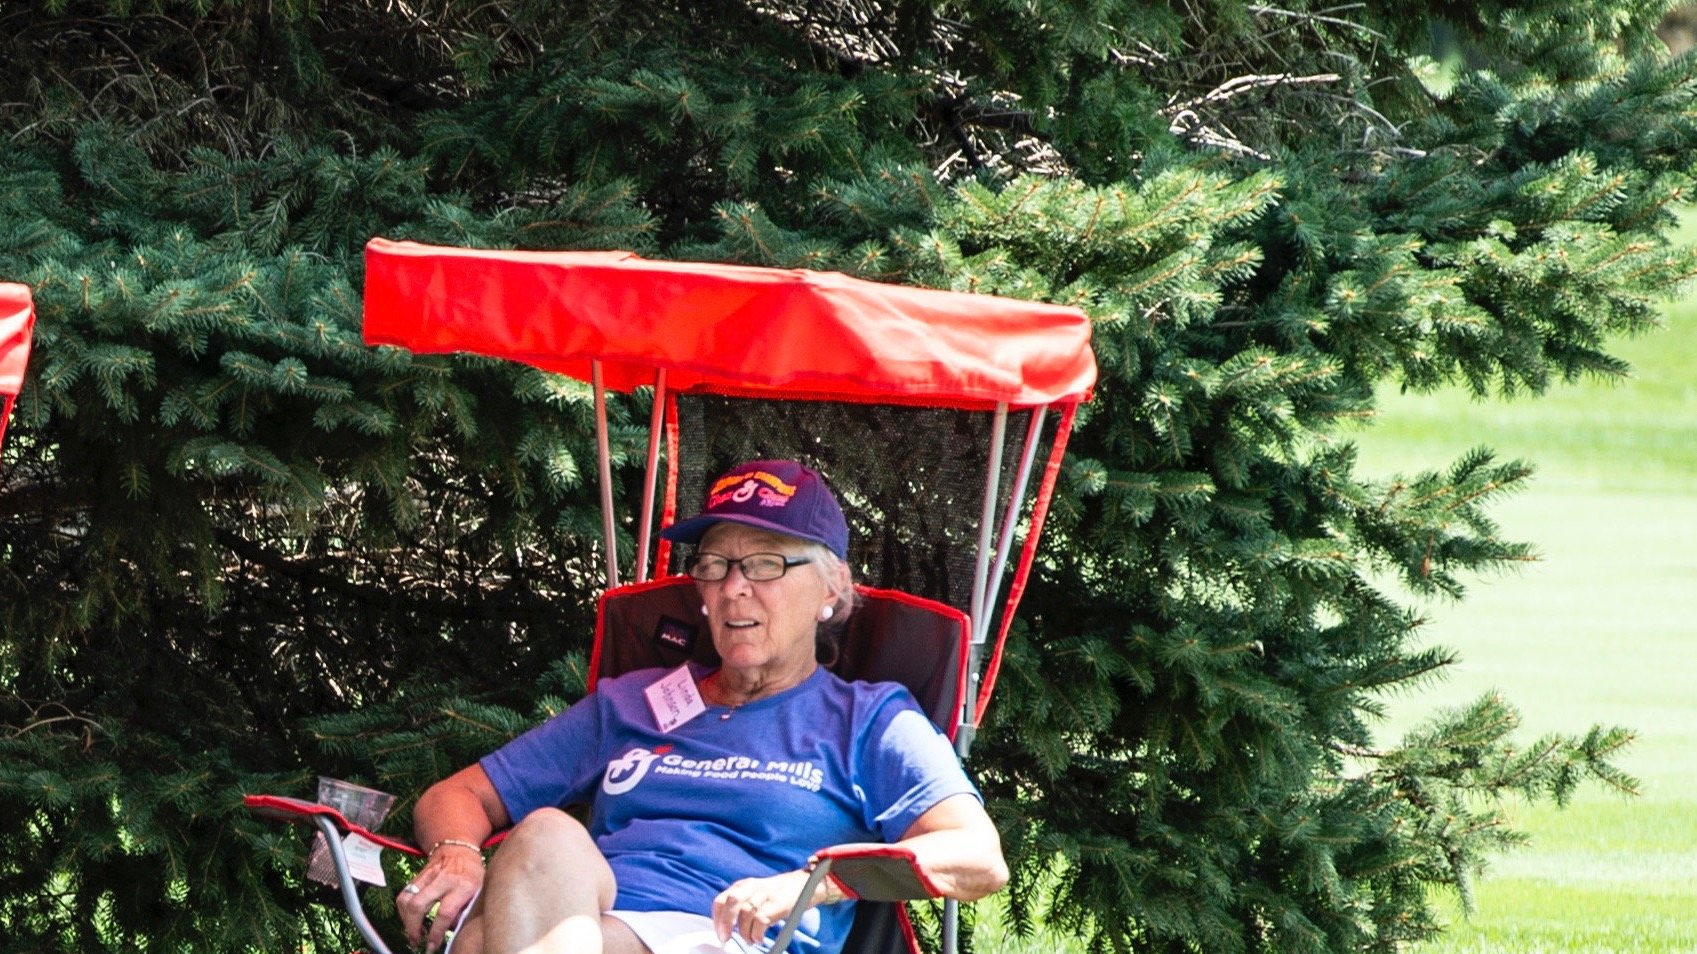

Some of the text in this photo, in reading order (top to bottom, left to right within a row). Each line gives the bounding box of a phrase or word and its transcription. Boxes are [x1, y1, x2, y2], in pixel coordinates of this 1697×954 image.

[654, 765, 821, 792] Making Food People Love
[662, 755, 824, 783] General Mills
